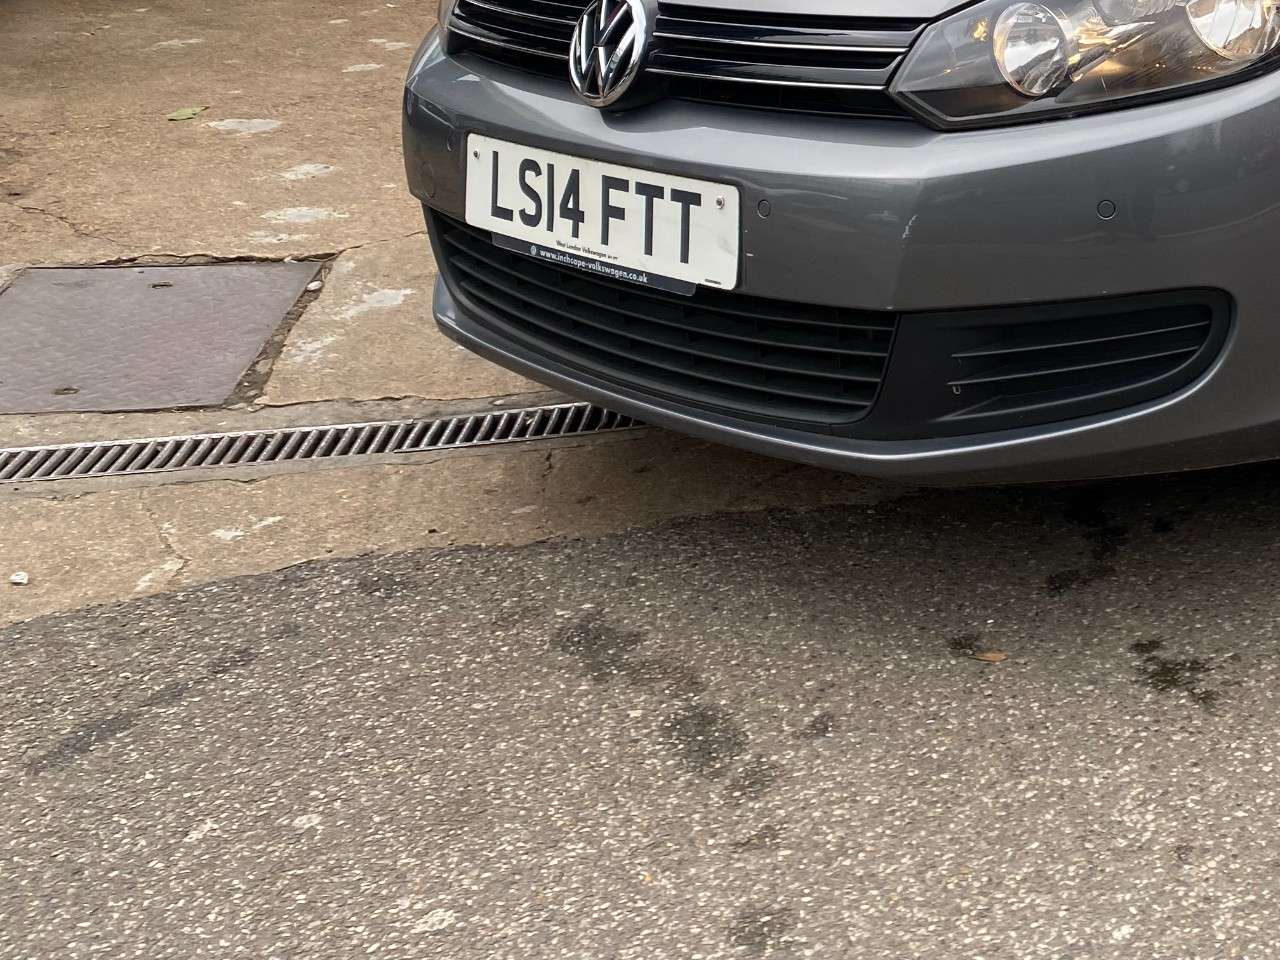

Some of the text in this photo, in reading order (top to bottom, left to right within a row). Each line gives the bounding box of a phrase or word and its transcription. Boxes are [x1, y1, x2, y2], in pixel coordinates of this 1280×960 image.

[491, 150, 702, 264] LS14 FTT
[539, 248, 648, 284] www.inchcape-volkswagen.co.uk
